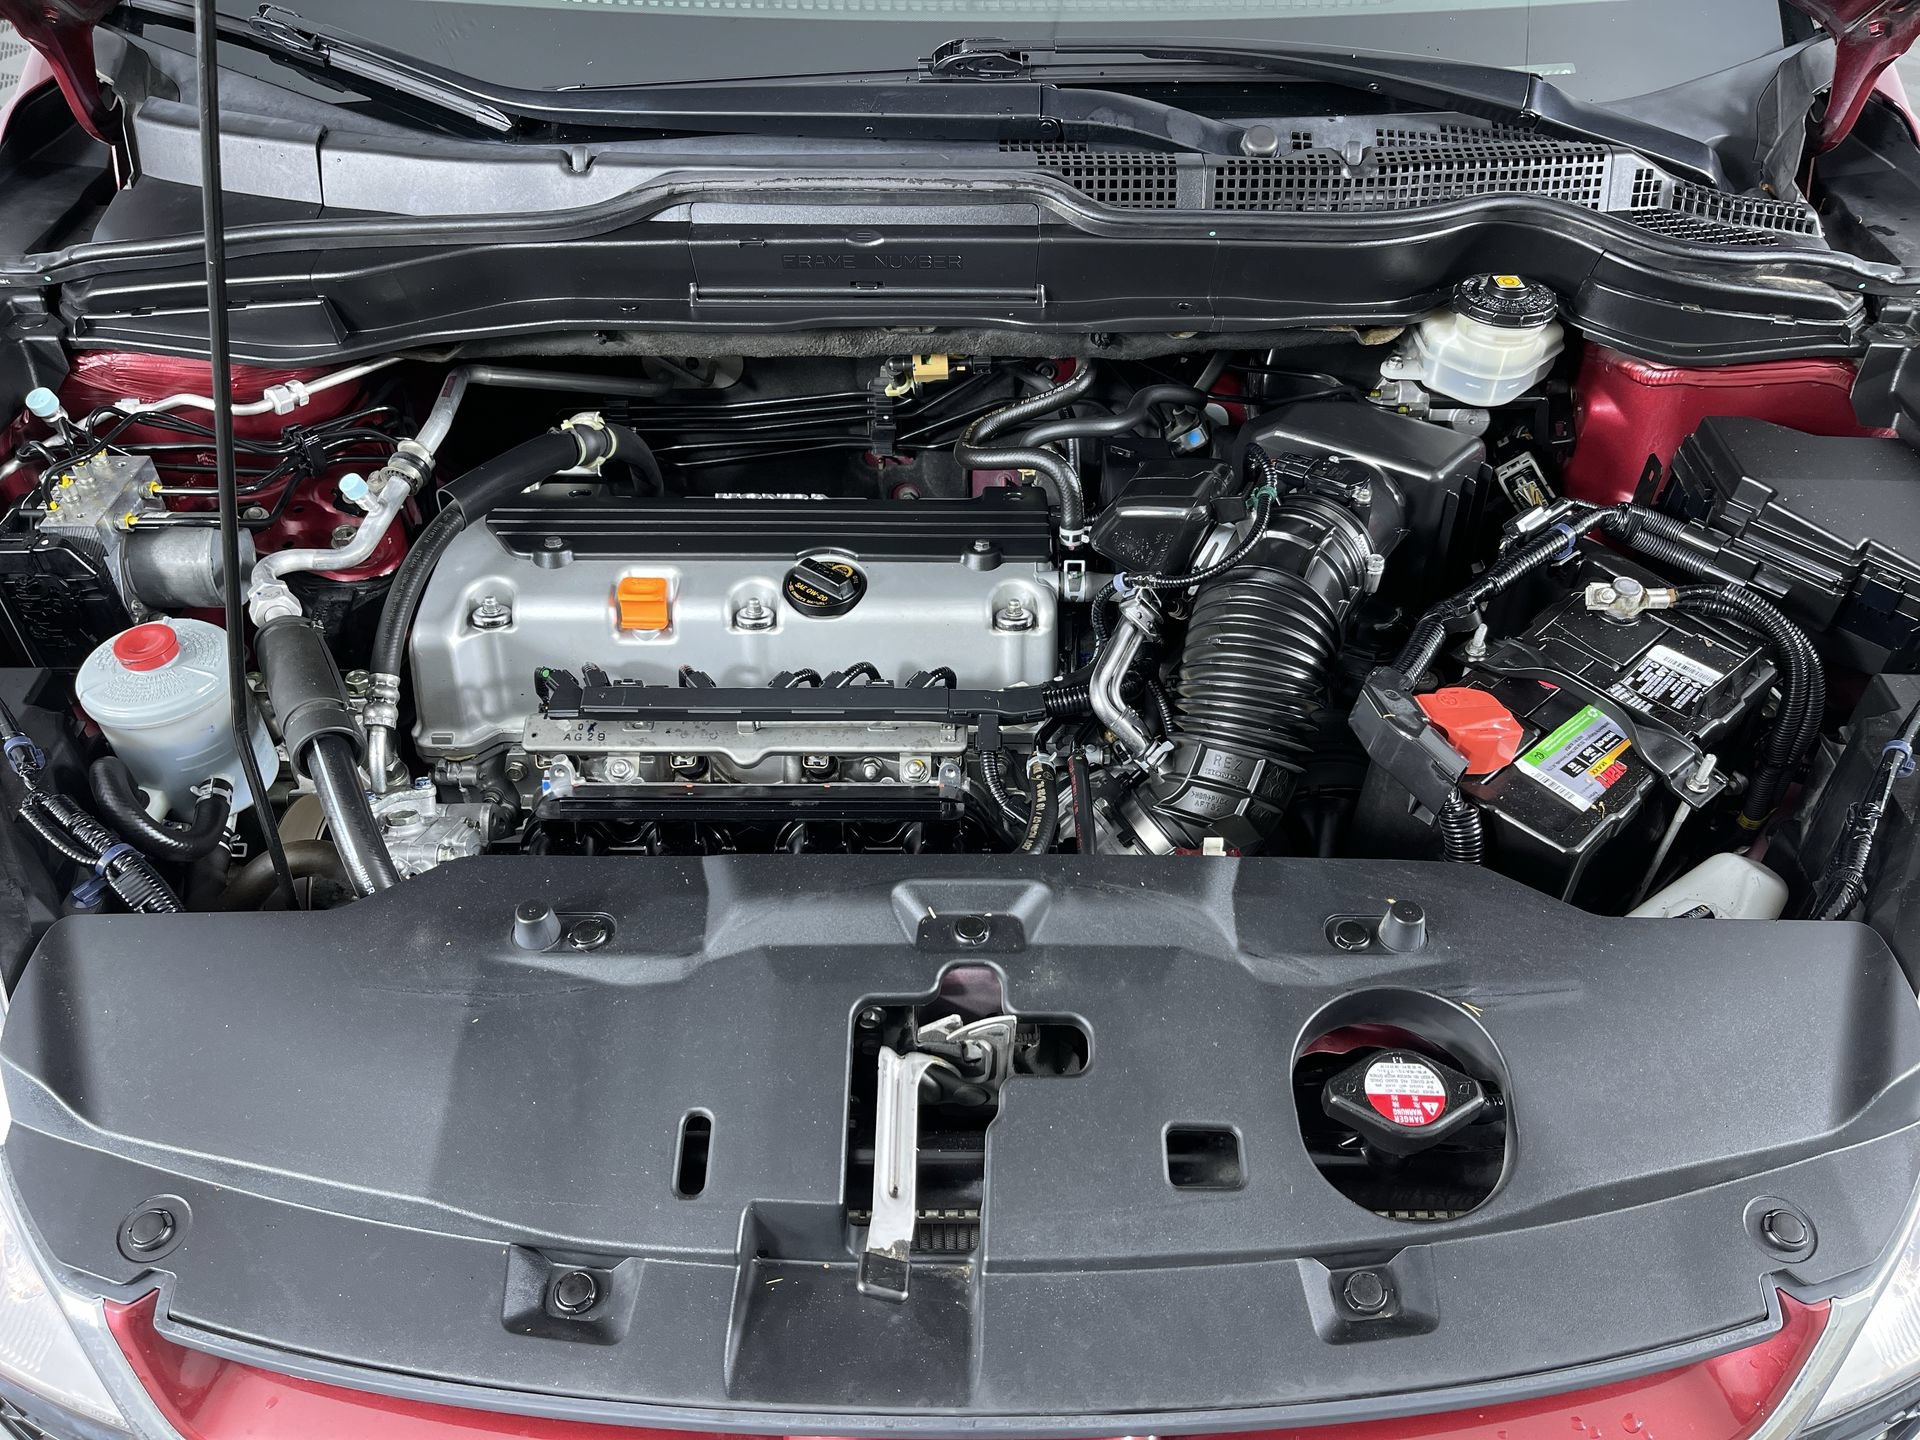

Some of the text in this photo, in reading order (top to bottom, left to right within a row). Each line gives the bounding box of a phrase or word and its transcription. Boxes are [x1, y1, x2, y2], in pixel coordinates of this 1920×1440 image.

[783, 255, 963, 269] FRAME NUMBER
[794, 581, 829, 602] SAE 0W-20
[563, 733, 606, 741] AG29
[1213, 754, 1244, 772] REZ
[359, 865, 376, 895] INNER
[1394, 1115, 1425, 1123] DANGER
